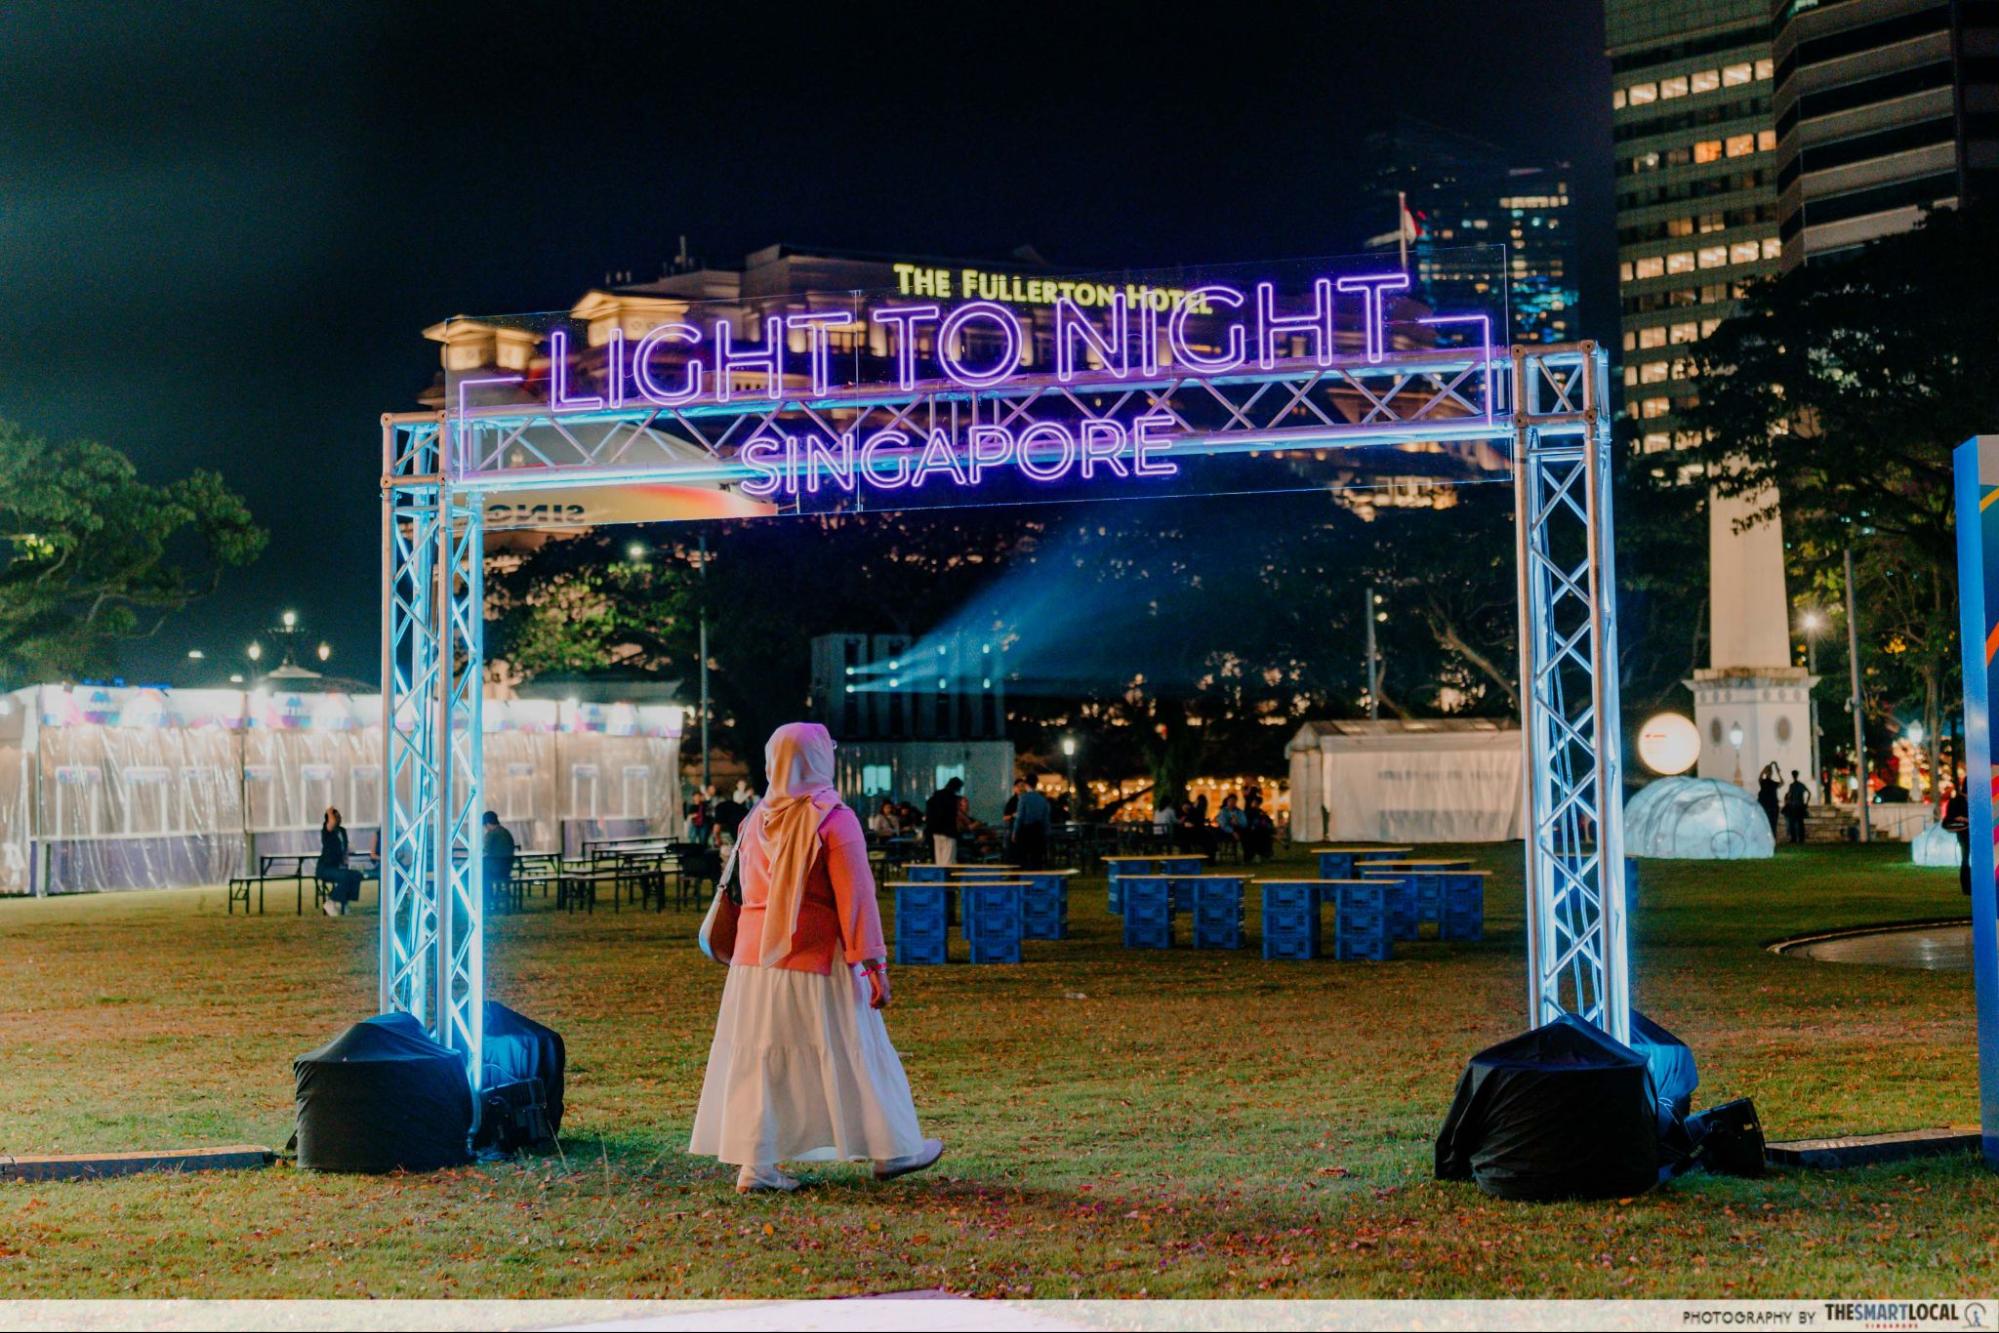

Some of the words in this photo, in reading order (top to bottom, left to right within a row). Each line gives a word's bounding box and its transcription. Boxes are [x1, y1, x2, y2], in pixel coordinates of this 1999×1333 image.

[893, 264, 951, 298] THE
[962, 269, 1116, 307] FULLERTON
[1126, 284, 1214, 315] HOTEL
[551, 311, 852, 412] LIGHT
[873, 302, 1023, 393] TO
[1056, 273, 1411, 383] NIGHT
[740, 415, 1179, 495] SINGAPORE
